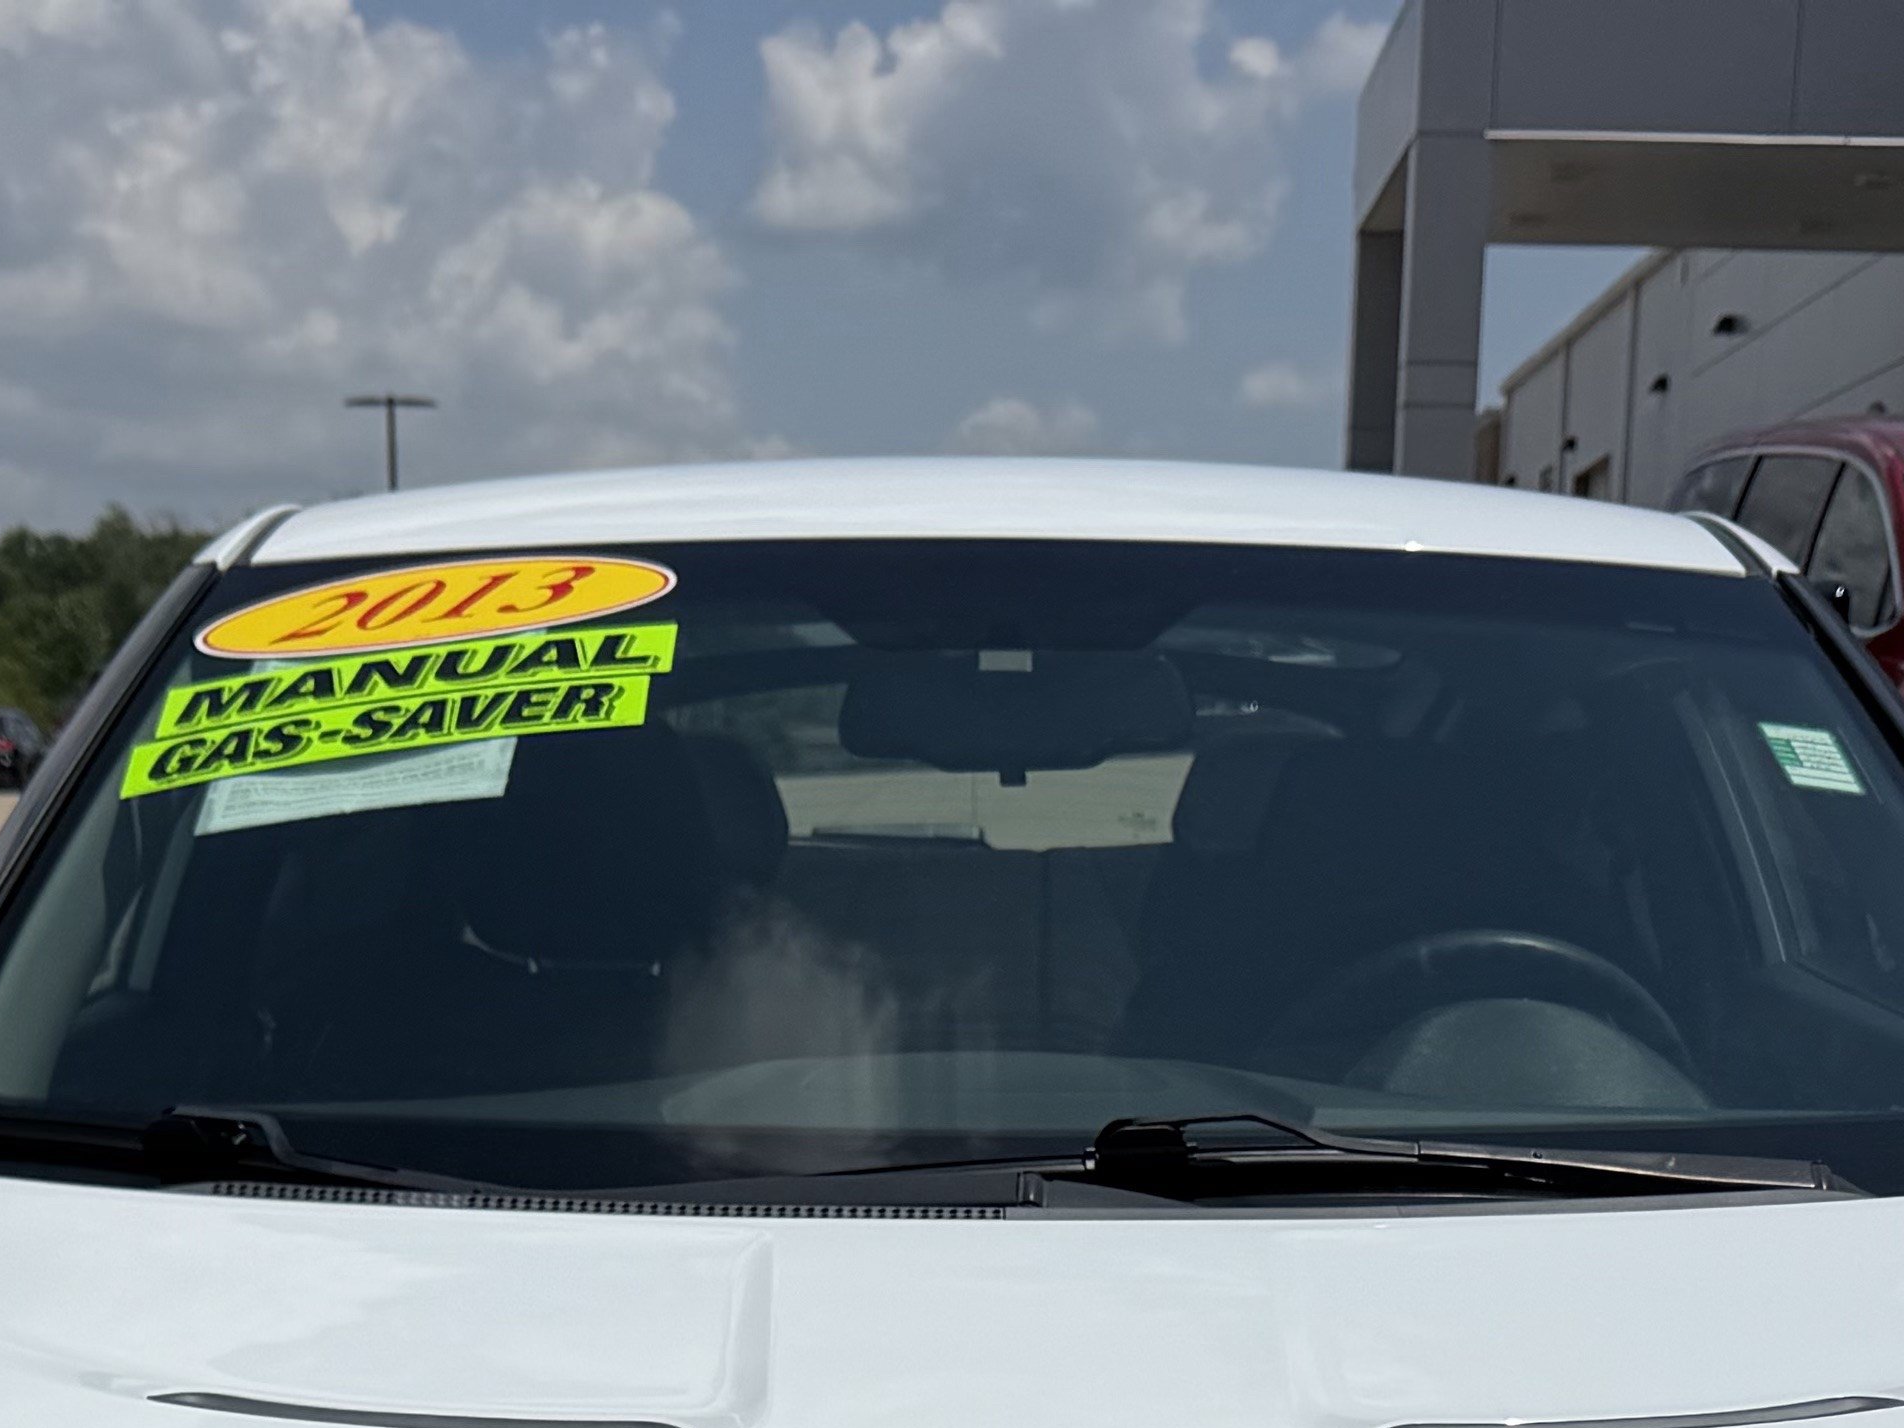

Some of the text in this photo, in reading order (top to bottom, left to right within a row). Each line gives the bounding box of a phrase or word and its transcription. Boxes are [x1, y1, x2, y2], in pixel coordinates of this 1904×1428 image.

[269, 565, 596, 646] 2013
[173, 631, 661, 729] MANUAL
[147, 681, 625, 783] GAS-SAVER
